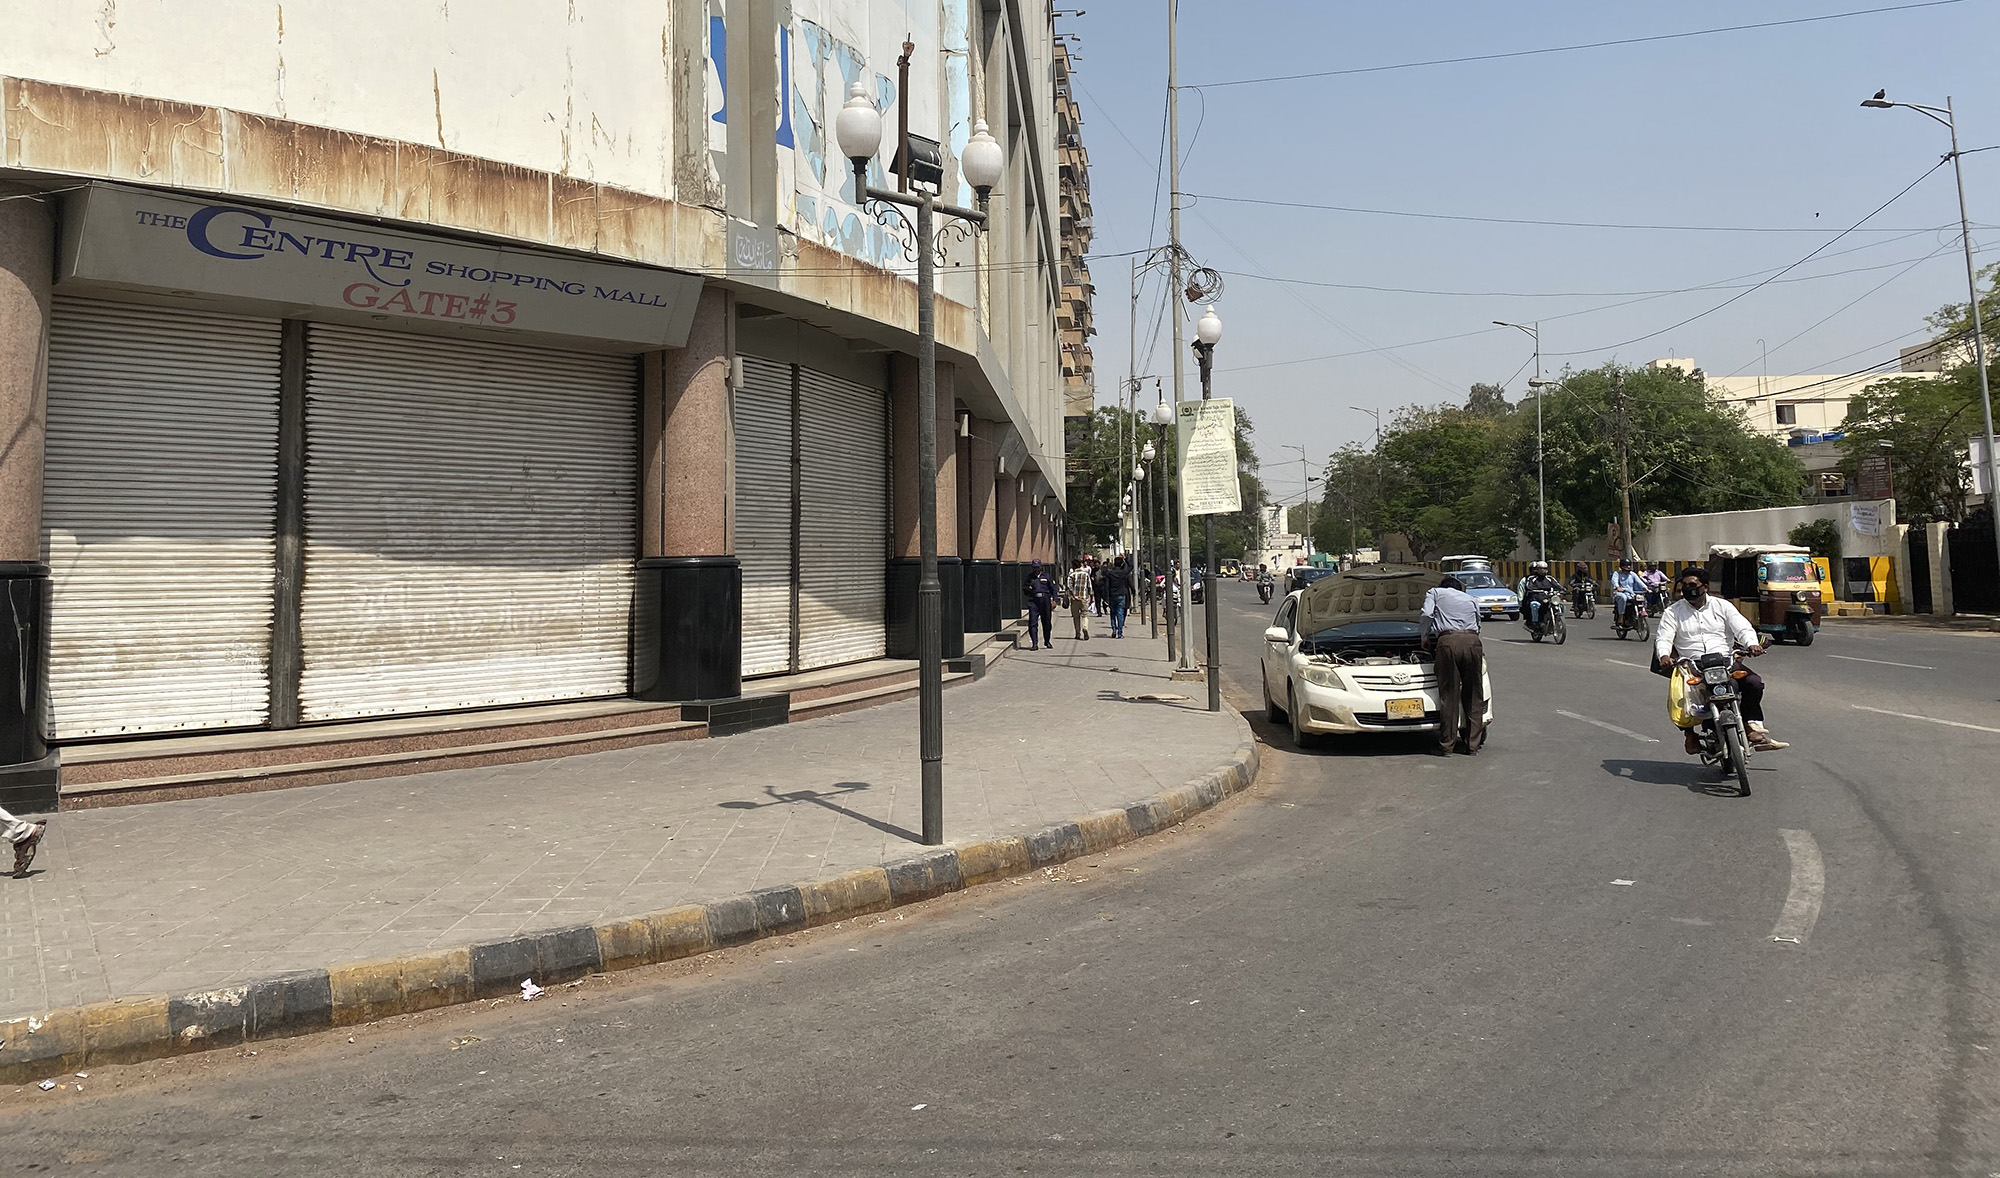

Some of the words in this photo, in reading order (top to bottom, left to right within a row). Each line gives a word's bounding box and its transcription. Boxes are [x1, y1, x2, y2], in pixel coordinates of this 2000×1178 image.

[136, 210, 188, 230] THE
[186, 205, 414, 287] CENTRE
[425, 260, 586, 295] SHOPPING
[593, 285, 668, 308] MALL
[342, 282, 518, 325] GATE#3
